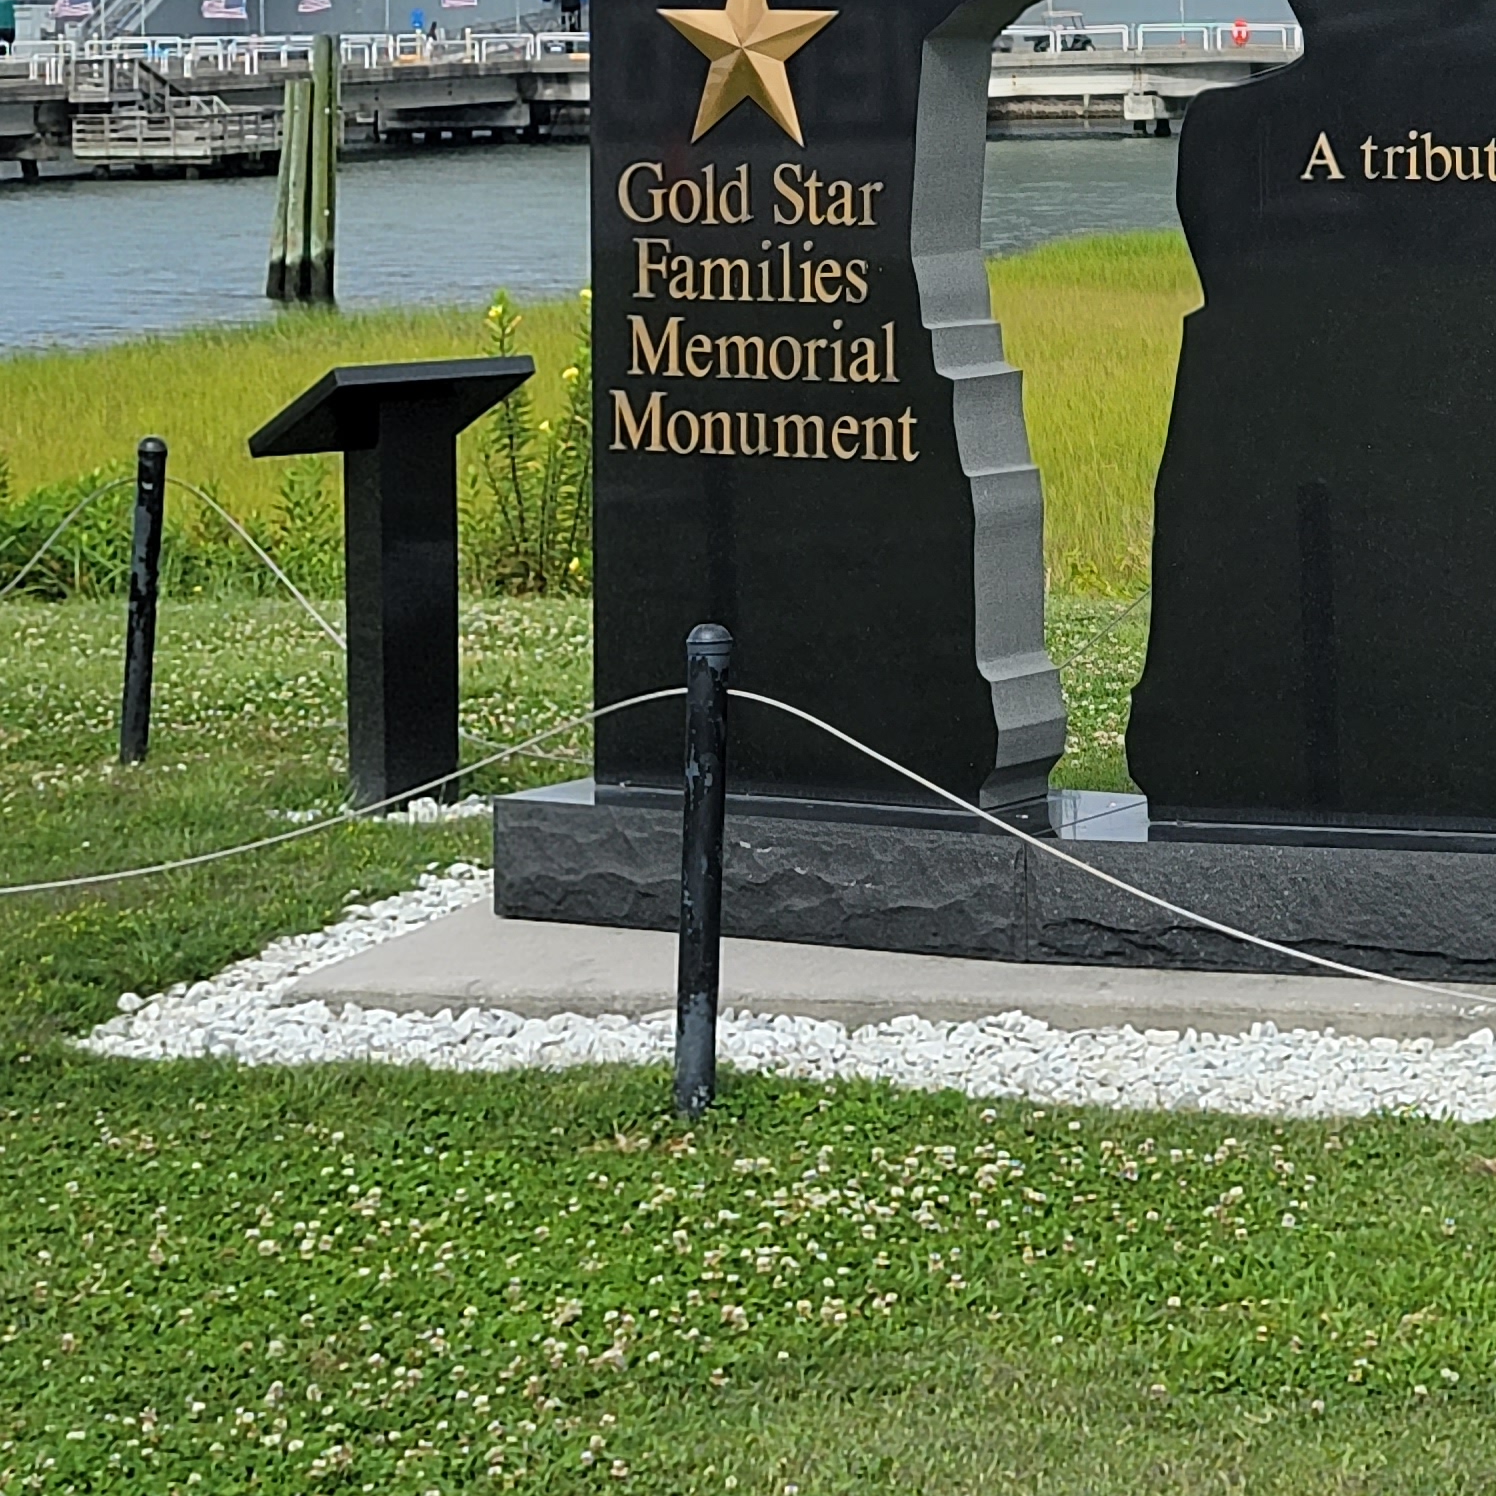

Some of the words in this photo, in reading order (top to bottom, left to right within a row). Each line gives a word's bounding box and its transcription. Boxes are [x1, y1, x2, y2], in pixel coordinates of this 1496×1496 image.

[1300, 131, 1345, 181] A
[618, 162, 753, 226] Gold
[773, 163, 884, 227] Star
[632, 237, 869, 304] Families
[627, 314, 900, 383] Memorial
[609, 389, 921, 462] Monument
